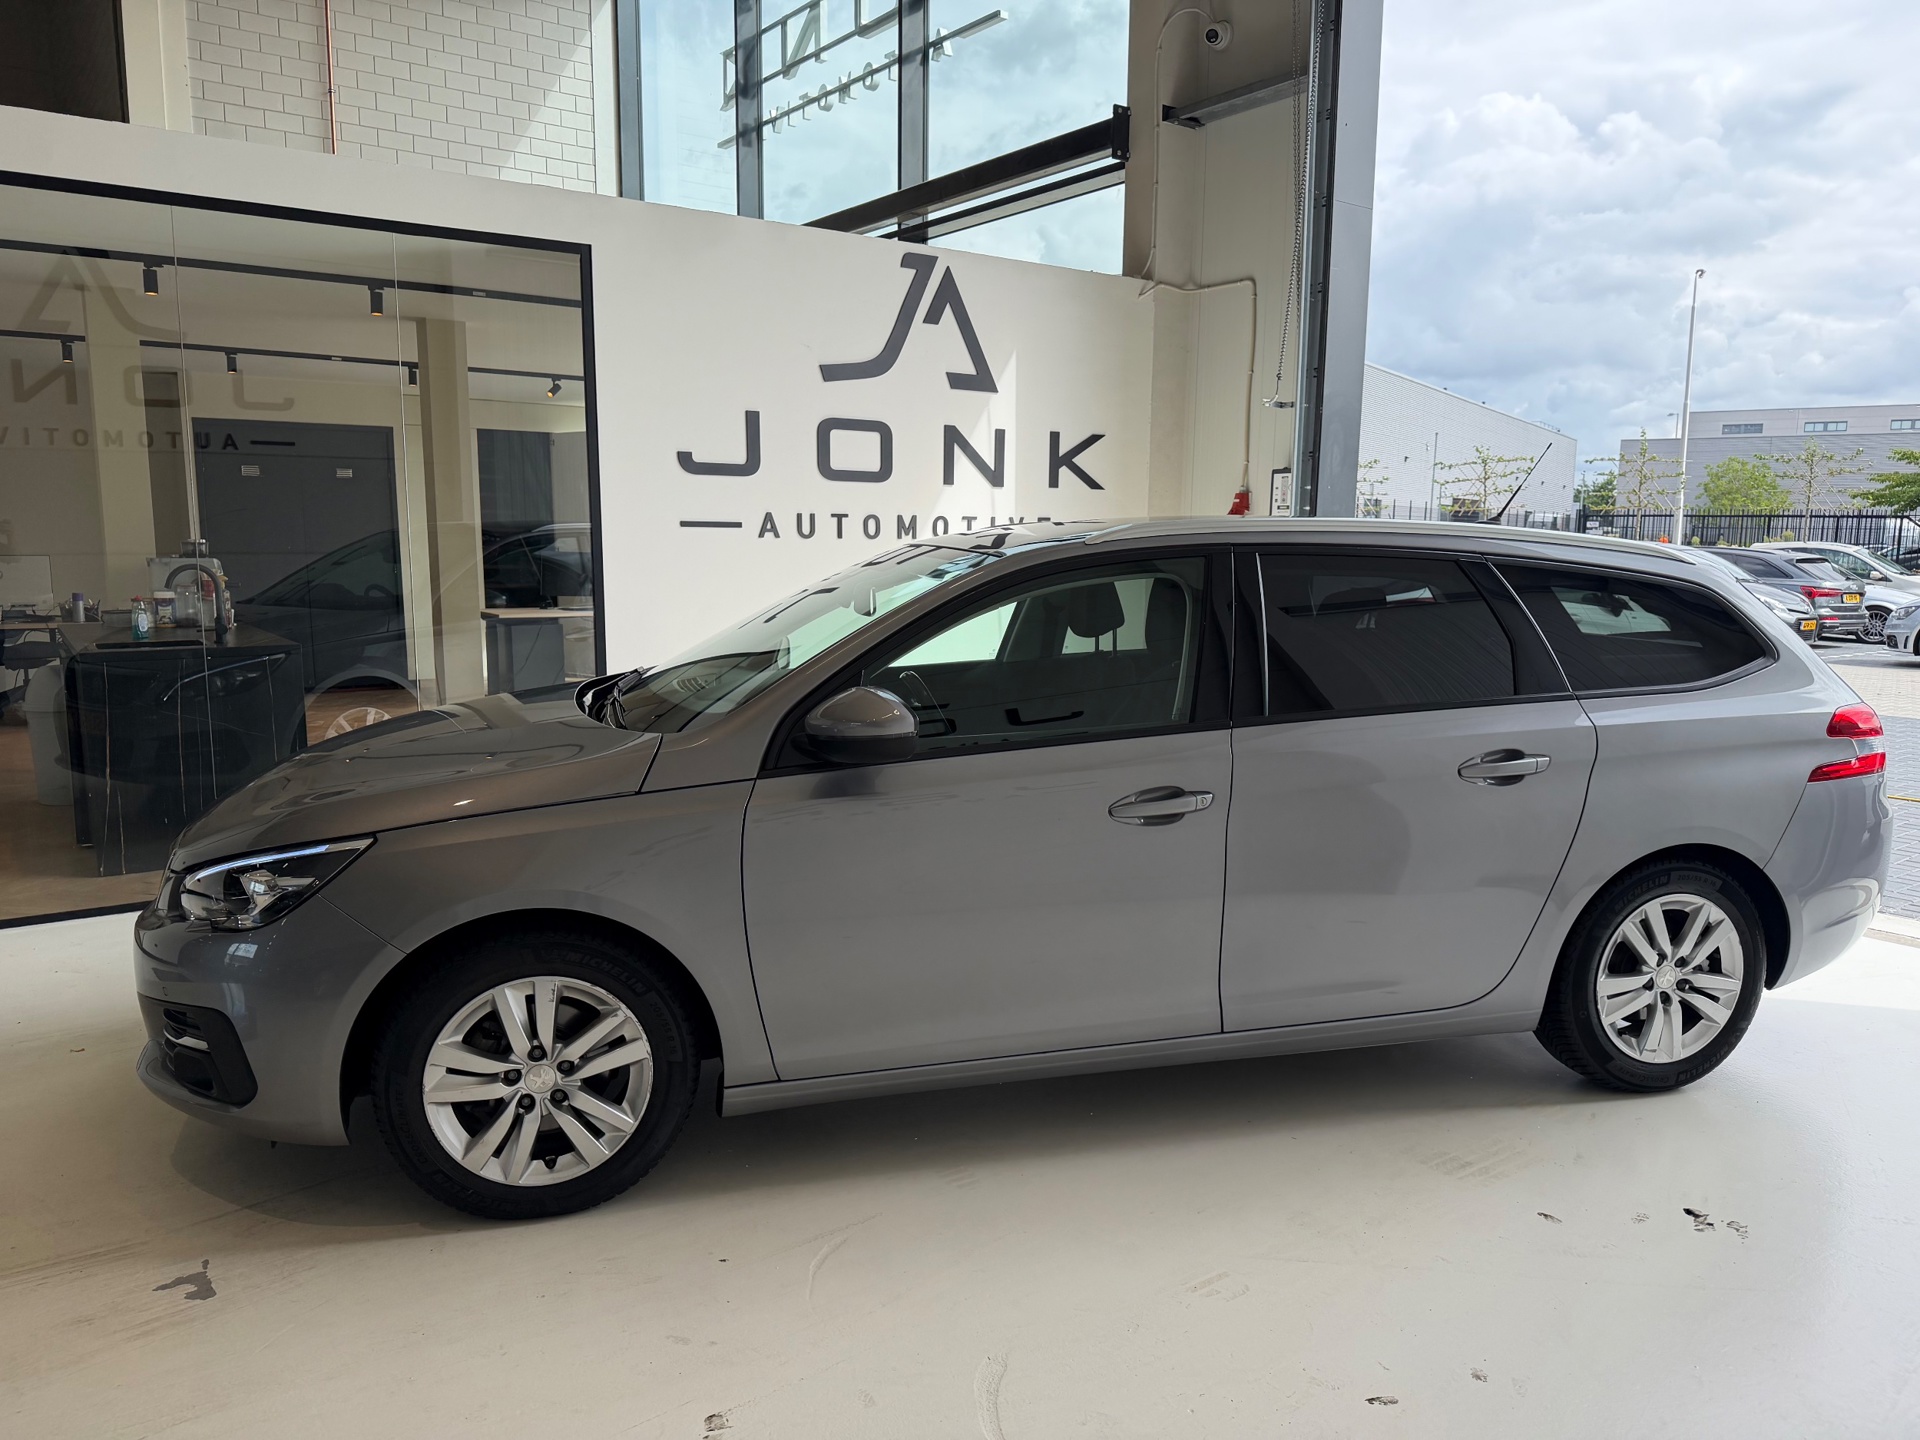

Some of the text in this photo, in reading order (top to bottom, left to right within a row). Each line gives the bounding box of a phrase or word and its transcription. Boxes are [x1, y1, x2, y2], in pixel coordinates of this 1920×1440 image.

[819, 252, 998, 393] JA
[677, 410, 1105, 490] JONK
[758, 511, 1052, 540] AUTOMOT
[1614, 874, 1669, 912] MICHELIN
[565, 952, 648, 995] MICHELIN
